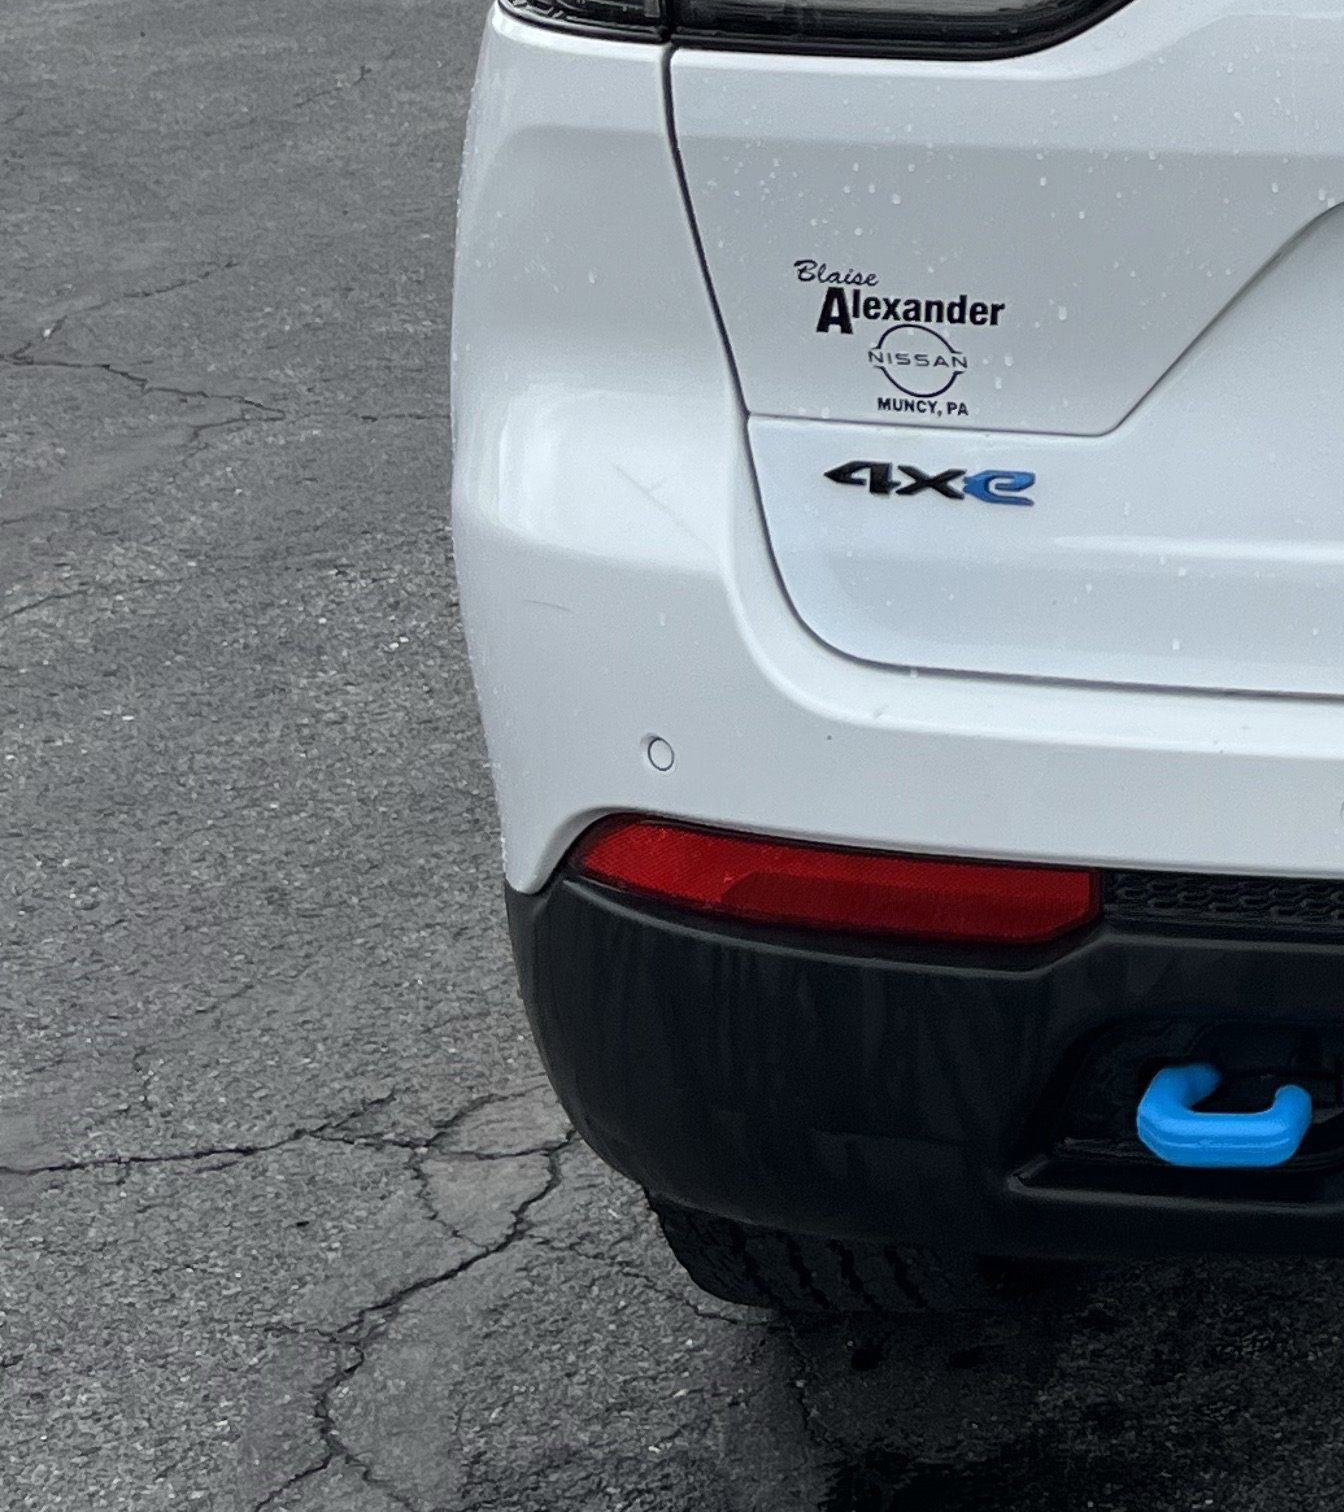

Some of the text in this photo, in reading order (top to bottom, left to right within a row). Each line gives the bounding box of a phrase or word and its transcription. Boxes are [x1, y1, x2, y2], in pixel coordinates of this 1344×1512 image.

[793, 258, 880, 287] Blaise
[815, 286, 1006, 335] Alexander
[867, 350, 969, 369] NISSAN
[876, 396, 969, 417] MUNCY, PA
